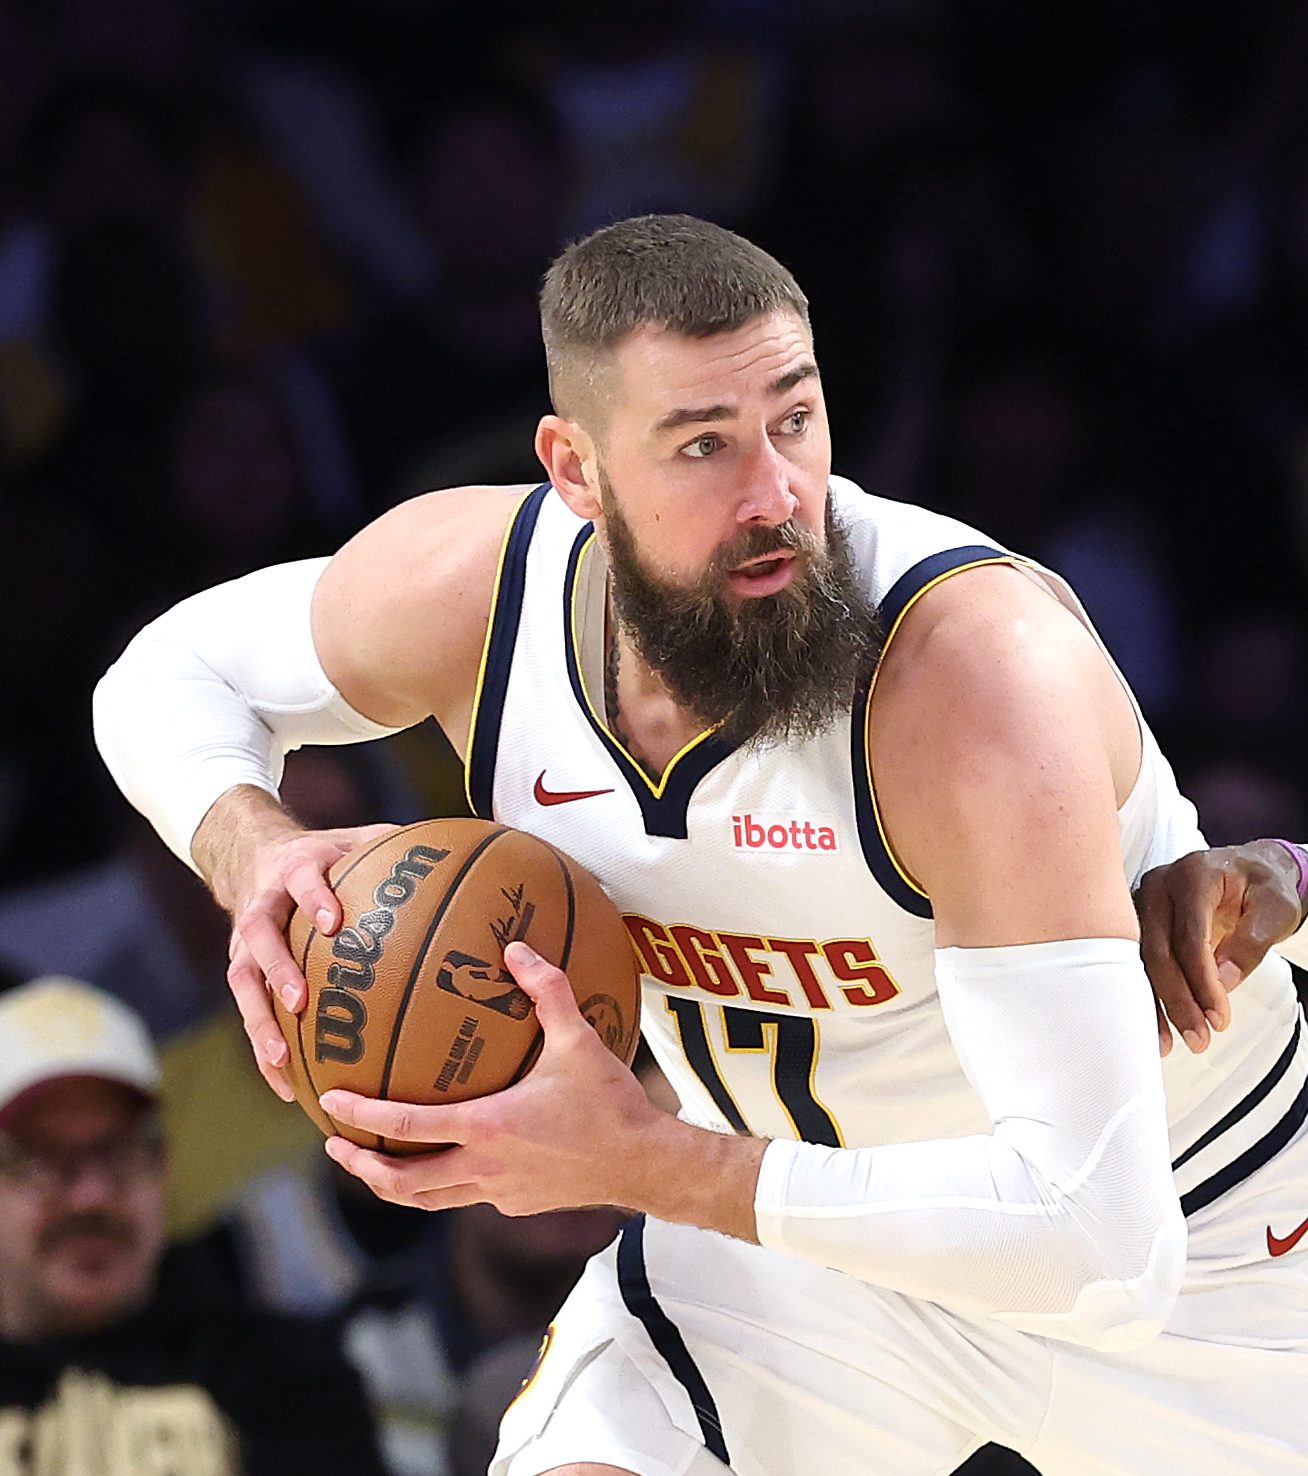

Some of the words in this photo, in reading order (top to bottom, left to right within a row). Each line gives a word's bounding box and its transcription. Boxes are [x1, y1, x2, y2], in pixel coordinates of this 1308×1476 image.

[732, 814, 837, 851] ibotta
[315, 845, 450, 1064] Wilson
[622, 914, 902, 1010] GGETS
[665, 994, 847, 1150] 17
